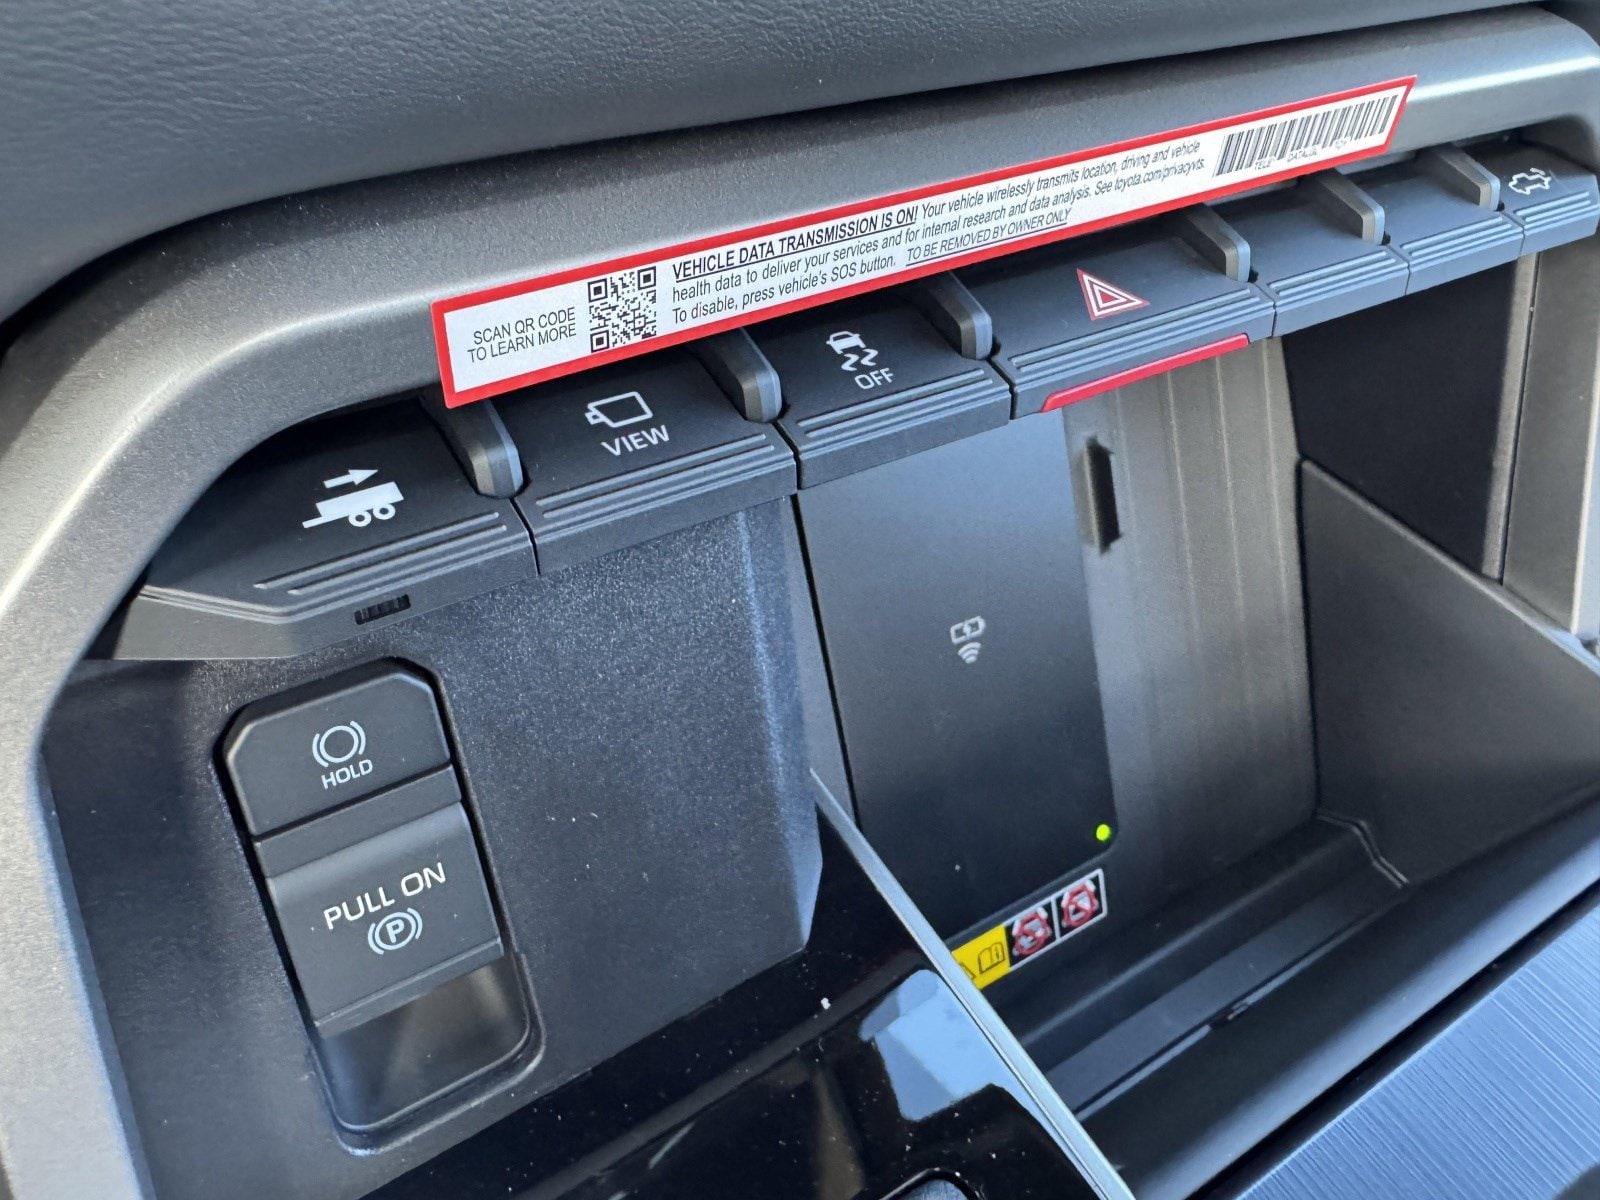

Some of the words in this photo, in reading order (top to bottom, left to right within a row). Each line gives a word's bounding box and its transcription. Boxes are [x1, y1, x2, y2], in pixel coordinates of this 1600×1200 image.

[672, 250, 735, 280] VEHICLE
[740, 240, 775, 264] DATA
[779, 214, 878, 254] TRANSMISSION
[881, 212, 893, 229] IS
[896, 205, 919, 224] ON!
[922, 202, 947, 219] Your
[948, 191, 984, 212] vehicle
[987, 178, 1035, 204] wirelessly
[1036, 169, 1080, 190] transmits
[1081, 160, 1118, 180] location,
[1121, 153, 1151, 170] driving
[1152, 146, 1171, 163] and
[1171, 140, 1200, 158] vehicle
[672, 277, 711, 303] health
[715, 272, 742, 292] data
[746, 268, 758, 284] to
[762, 258, 802, 280] deliver
[804, 250, 831, 273] your
[832, 239, 879, 262] services
[881, 229, 903, 250] and
[905, 227, 920, 244] for
[921, 216, 961, 239] internal
[962, 207, 1006, 229] research
[1008, 199, 1029, 217] and
[1029, 194, 1051, 213] data
[1052, 183, 1091, 206] analysis.
[1094, 179, 1113, 196] See
[907, 245, 922, 262] TO
[923, 241, 939, 257] BE
[940, 228, 991, 254] REMOVED
[992, 222, 1007, 240] BY
[1007, 213, 1044, 236] OWNER
[1045, 207, 1073, 226] ONLY
[672, 307, 687, 324] To
[691, 294, 738, 320] disable,
[742, 286, 775, 310] press
[779, 269, 827, 297] vehicle's
[830, 261, 857, 283] SOS
[860, 254, 896, 275] button.
[467, 346, 487, 363] TO
[490, 333, 534, 358] LEARN
[538, 323, 576, 345] MORE
[473, 323, 511, 345] SCAN
[515, 318, 535, 334] QR
[538, 307, 576, 328] CODE
[854, 367, 894, 390] OFF
[600, 424, 670, 456] VIEW
[320, 759, 374, 790] HOLD
[323, 886, 396, 930] PULL
[400, 861, 447, 897] ON
[385, 918, 406, 944] P
